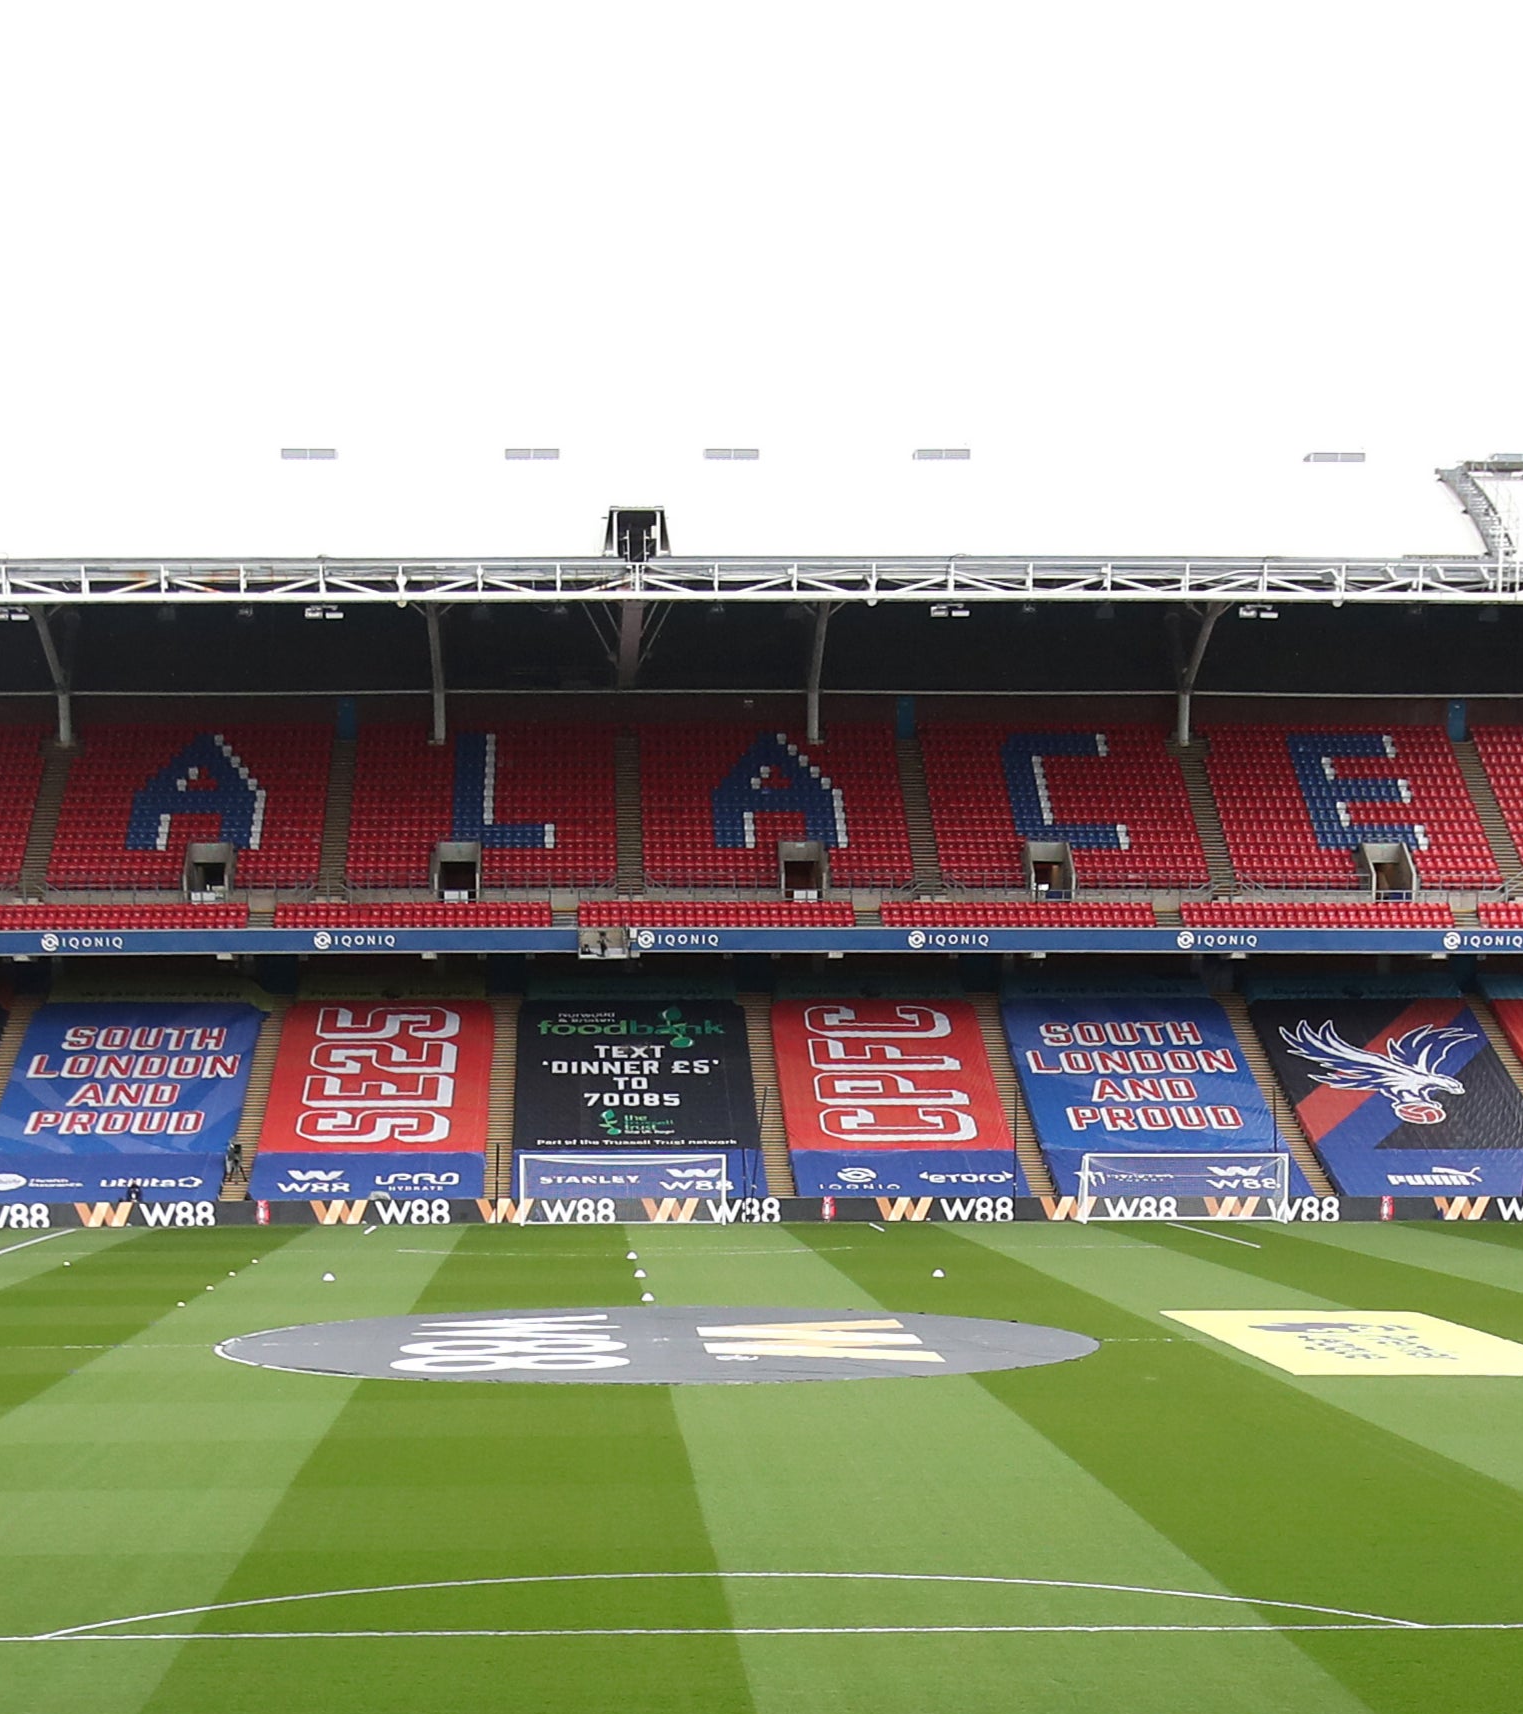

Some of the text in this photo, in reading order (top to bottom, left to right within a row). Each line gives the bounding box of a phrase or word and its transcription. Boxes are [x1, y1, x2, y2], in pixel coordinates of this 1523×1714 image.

[62, 936, 124, 951] IQONIQ
[335, 934, 396, 949] IQONIQ
[657, 934, 719, 947] IQONIQ
[928, 934, 989, 947] IQONIQ
[1197, 935, 1259, 947] IQONIQ
[1463, 935, 1523, 947] IQONIQ
[61, 1025, 227, 1052] SOUTH
[1038, 1020, 1202, 1046] SOUTH
[593, 1044, 666, 1059] TEXT
[1026, 1048, 1239, 1075] LONDON
[24, 1053, 242, 1080] LONDON
[612, 1076, 649, 1091] TO
[1092, 1078, 1199, 1103] AND
[66, 1082, 181, 1108] AND
[583, 1093, 681, 1107] 70085
[23, 1111, 205, 1136] PROUD
[1067, 1106, 1245, 1131] PROUD
[277, 1182, 350, 1193] W88
[540, 1174, 641, 1185] STANLEY
[138, 1201, 216, 1228] W88
[374, 1198, 451, 1225] W88
[541, 1197, 617, 1224] W88
[939, 1196, 1015, 1222] W88
[1103, 1196, 1178, 1219] W88
[1266, 1196, 1340, 1222] W88
